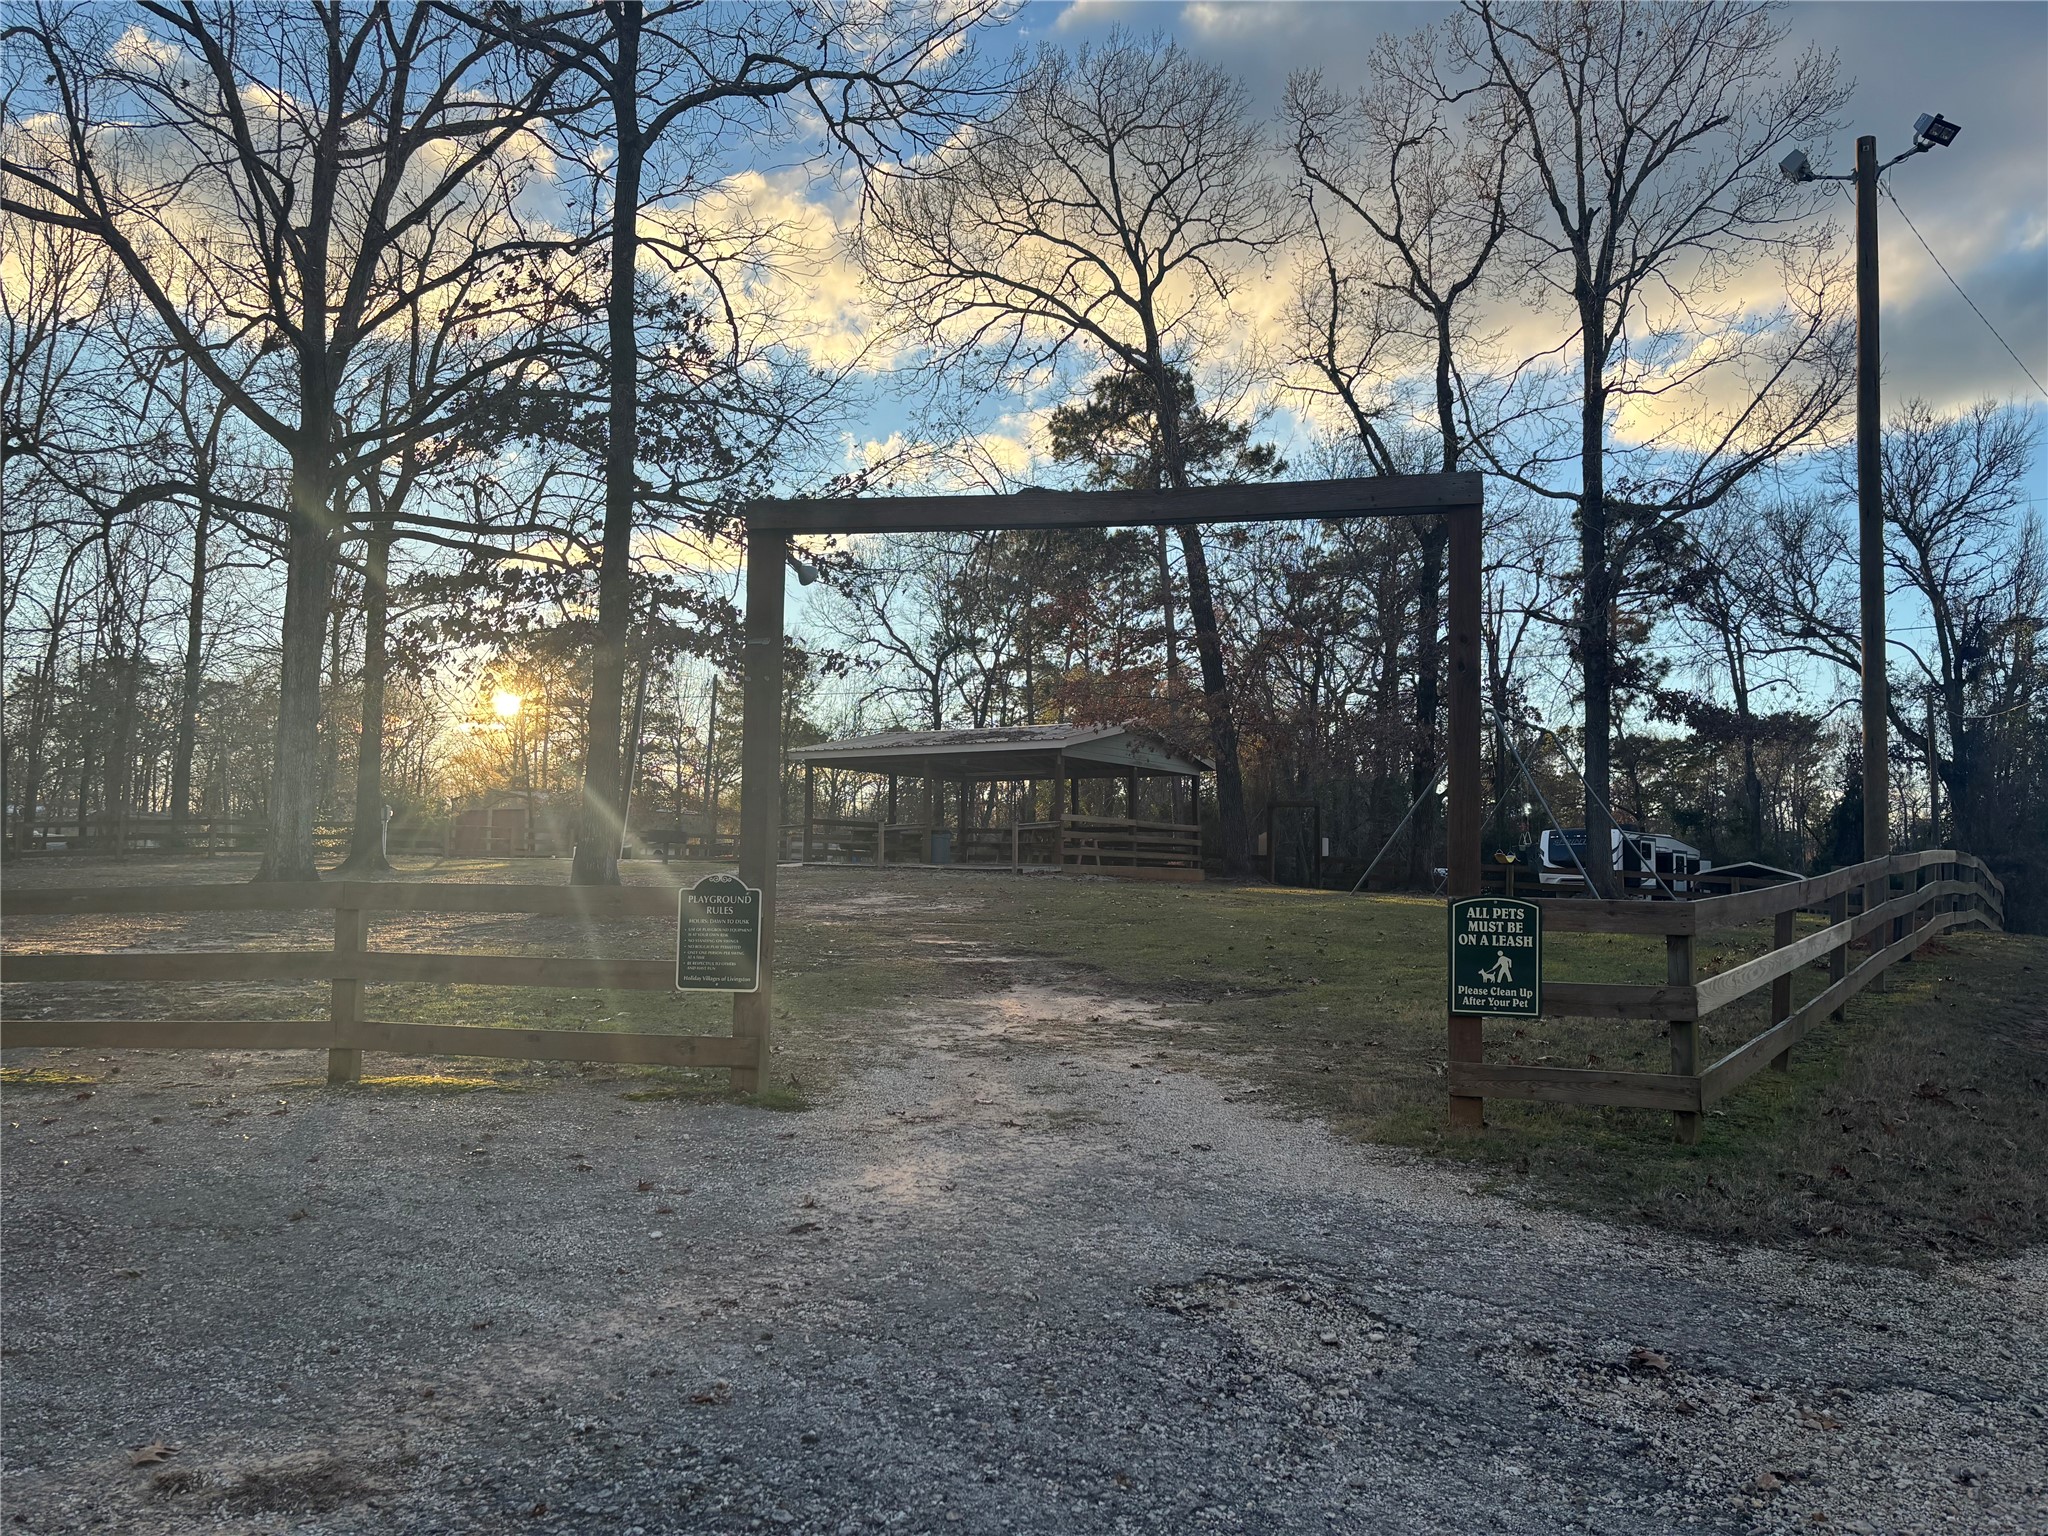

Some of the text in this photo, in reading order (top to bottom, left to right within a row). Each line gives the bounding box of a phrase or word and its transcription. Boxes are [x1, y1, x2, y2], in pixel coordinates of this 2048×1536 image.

[688, 895, 752, 904] PLAYGROUND
[706, 906, 733, 914] RULES
[1467, 907, 1525, 920] ALL PETS
[1468, 921, 1524, 934] MUST BE
[1458, 934, 1533, 948] ON A LEASH
[683, 975, 702, 983] Holiday
[702, 975, 721, 983] Villages
[1458, 985, 1533, 999] Please Clean Up
[1462, 996, 1529, 1008] After Your Pet
